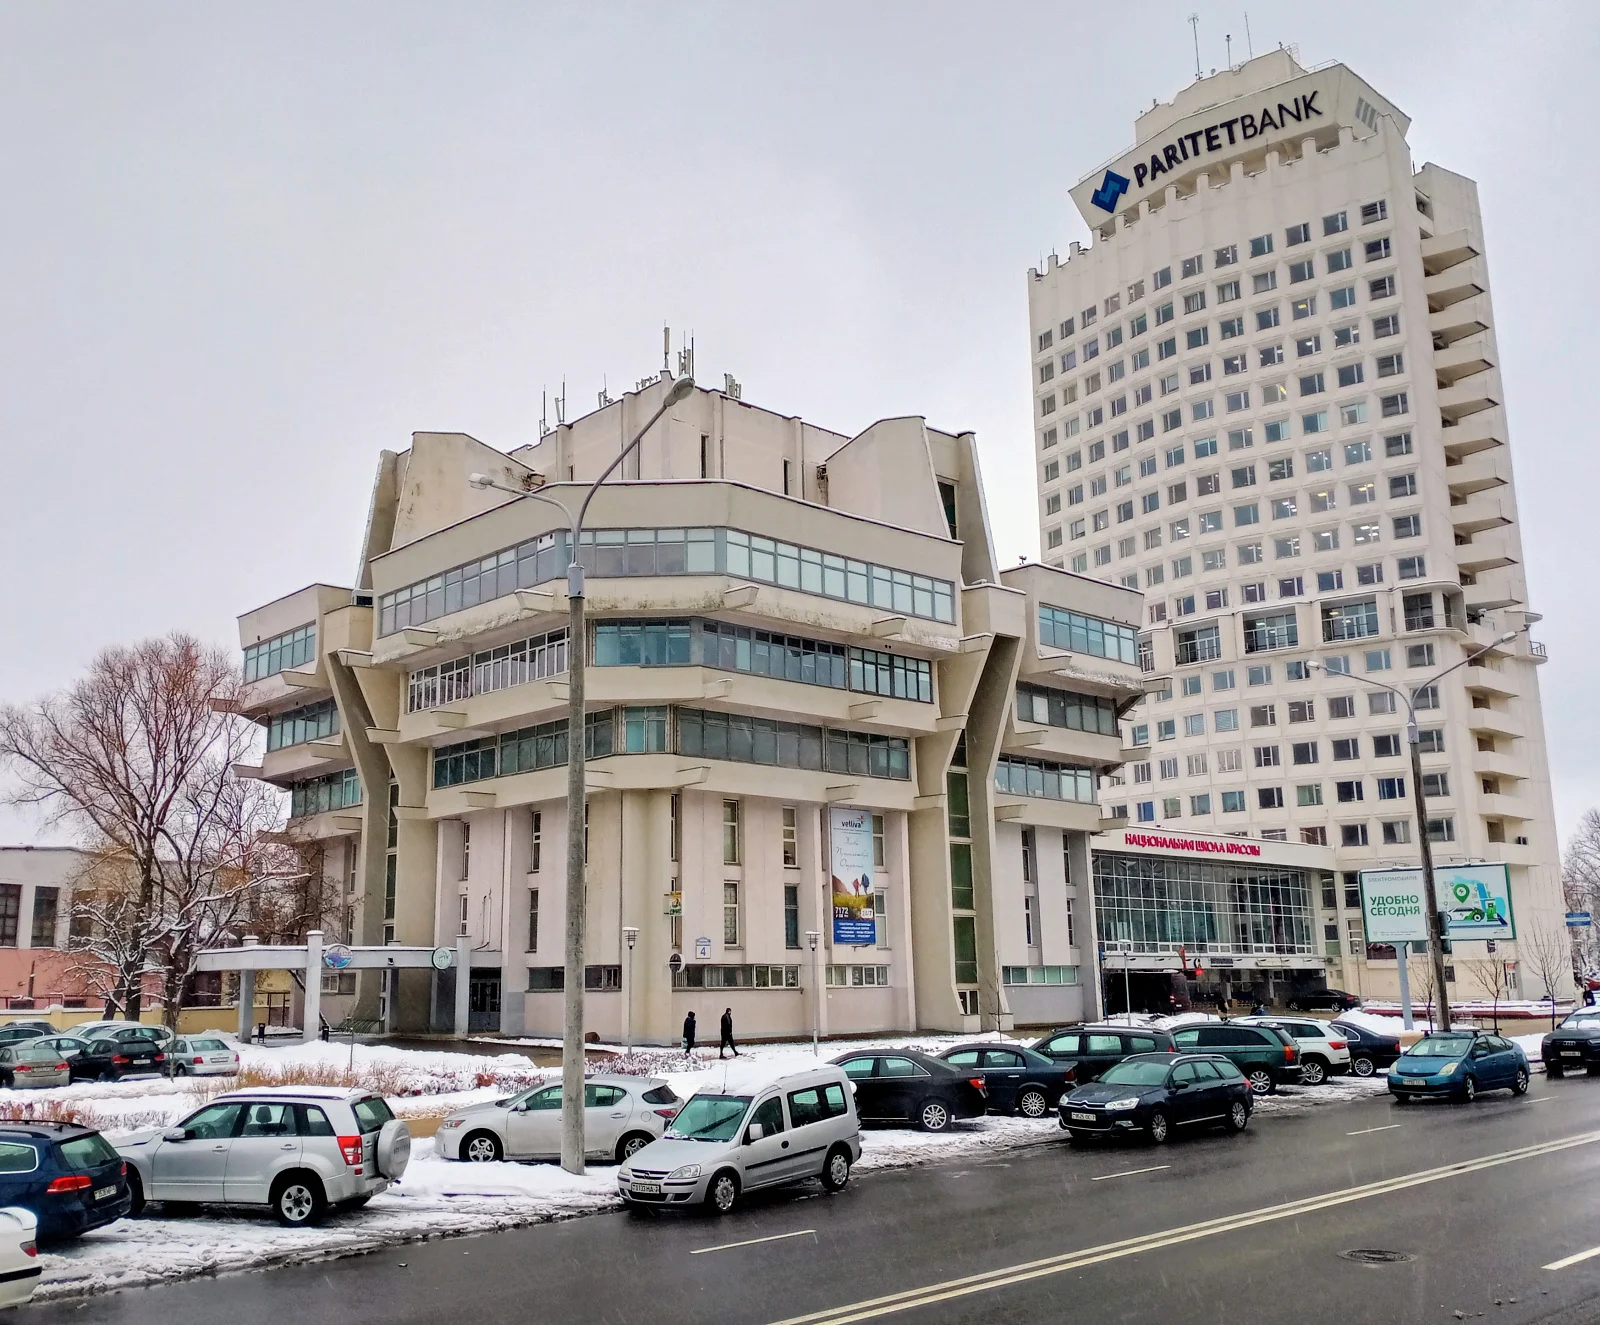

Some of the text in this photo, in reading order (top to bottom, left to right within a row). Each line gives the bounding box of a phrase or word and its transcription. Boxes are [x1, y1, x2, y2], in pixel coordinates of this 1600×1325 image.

[1133, 90, 1323, 188] PARITETBANK
[1125, 833, 1260, 856] НАЦИОНАЛЬНАЯ ШКОЛА КРАСОТЫ
[1370, 895, 1419, 907] УДОБНО
[1370, 906, 1421, 917] СЕГОДНЯ
[700, 947, 706, 956] 4
